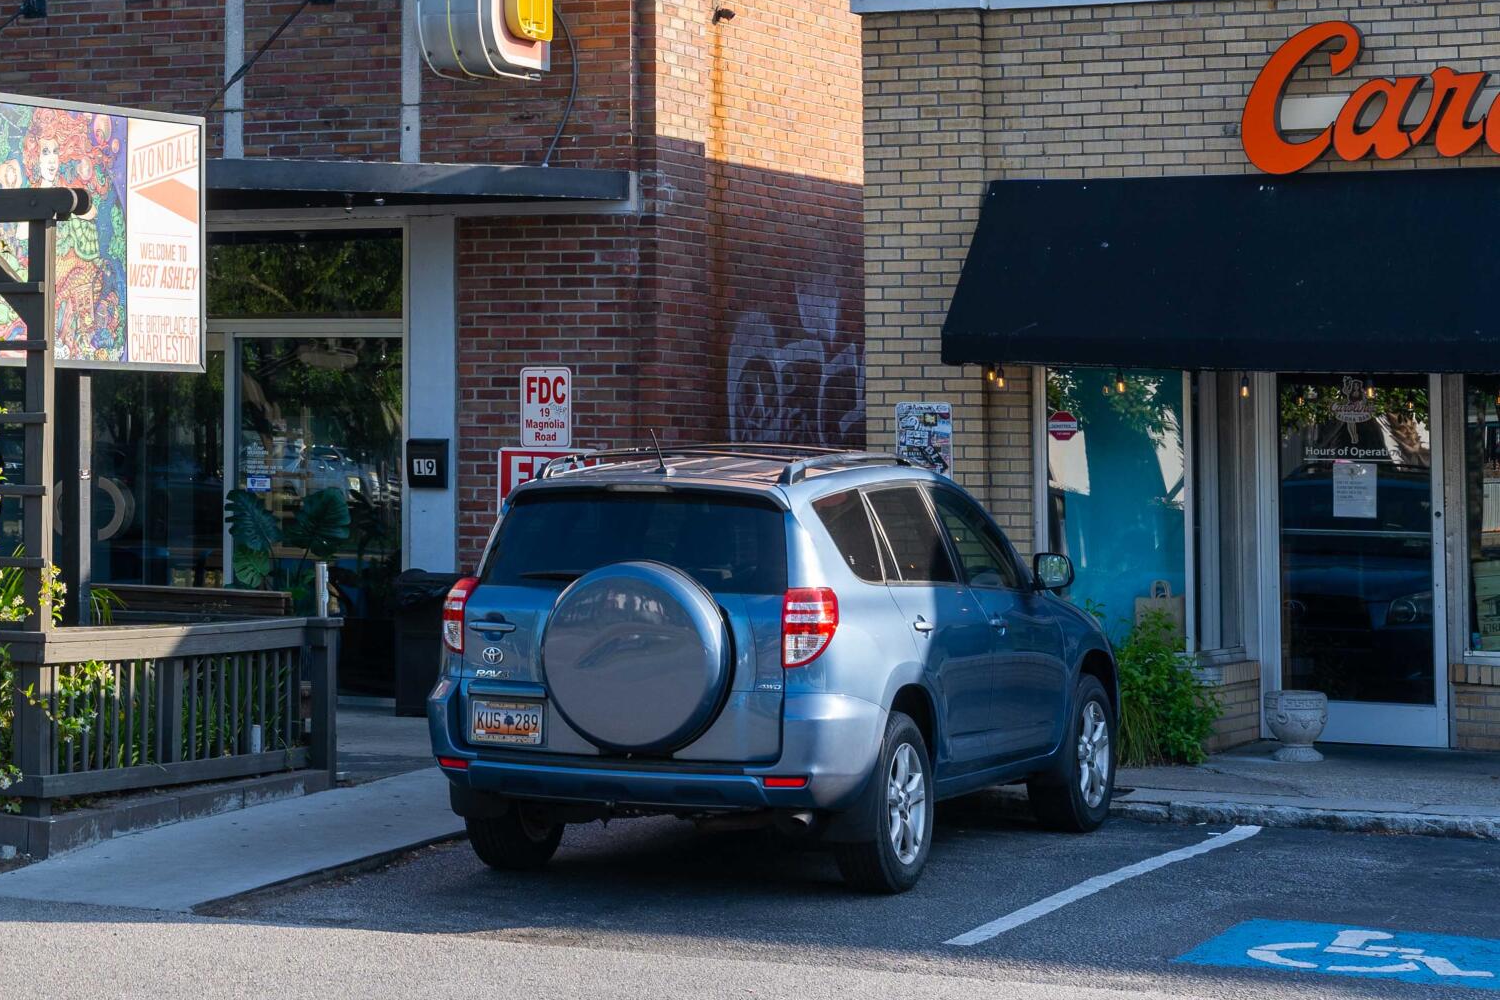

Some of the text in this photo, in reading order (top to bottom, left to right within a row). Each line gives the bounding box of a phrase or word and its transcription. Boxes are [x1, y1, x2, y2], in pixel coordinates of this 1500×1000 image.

[130, 133, 198, 184] AVONDALE
[140, 243, 187, 262] WELCOME TO
[129, 264, 198, 290] WEST ASHLEY
[130, 314, 198, 336] THE BIRTHPLACE OF
[131, 333, 198, 363] CHARLESTON
[526, 376, 566, 405] FDC
[540, 408, 550, 417] 19
[525, 419, 565, 431] Magnolia
[535, 432, 557, 441] Road
[1305, 446, 1402, 458] Hours of Operation
[415, 460, 435, 474] 19
[477, 711, 539, 732] KUS 289
